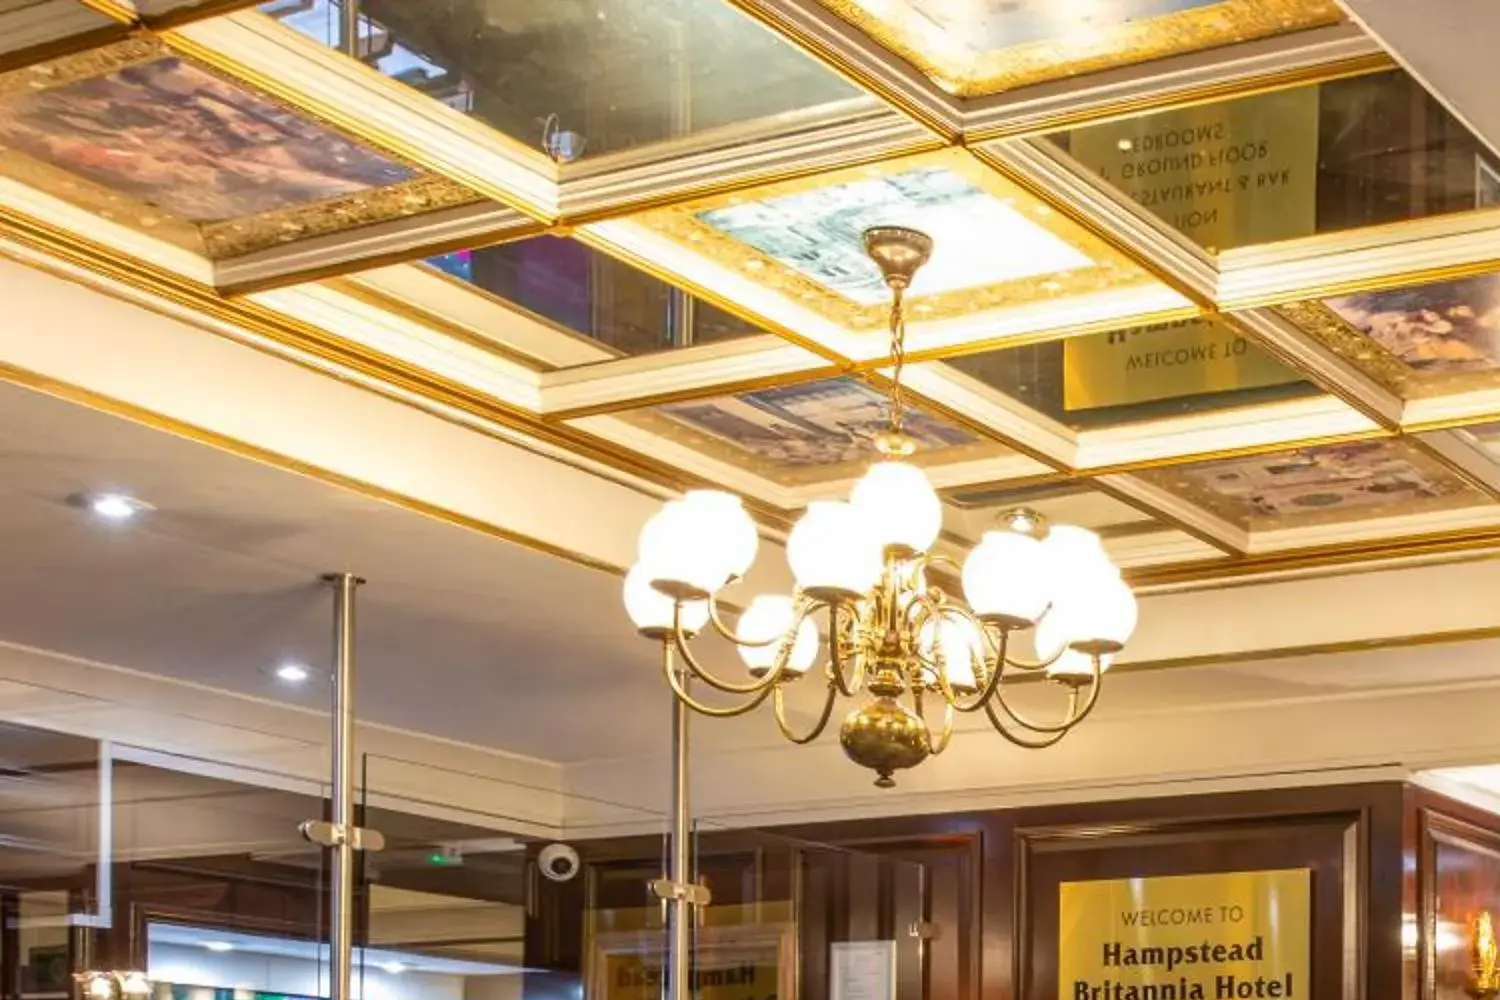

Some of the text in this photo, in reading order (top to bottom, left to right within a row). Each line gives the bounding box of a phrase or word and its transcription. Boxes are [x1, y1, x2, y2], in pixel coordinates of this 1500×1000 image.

[1121, 905, 1244, 927] WELCOME TO
[1102, 936, 1264, 972] Hampstead
[1215, 972, 1294, 1000] Hotel
